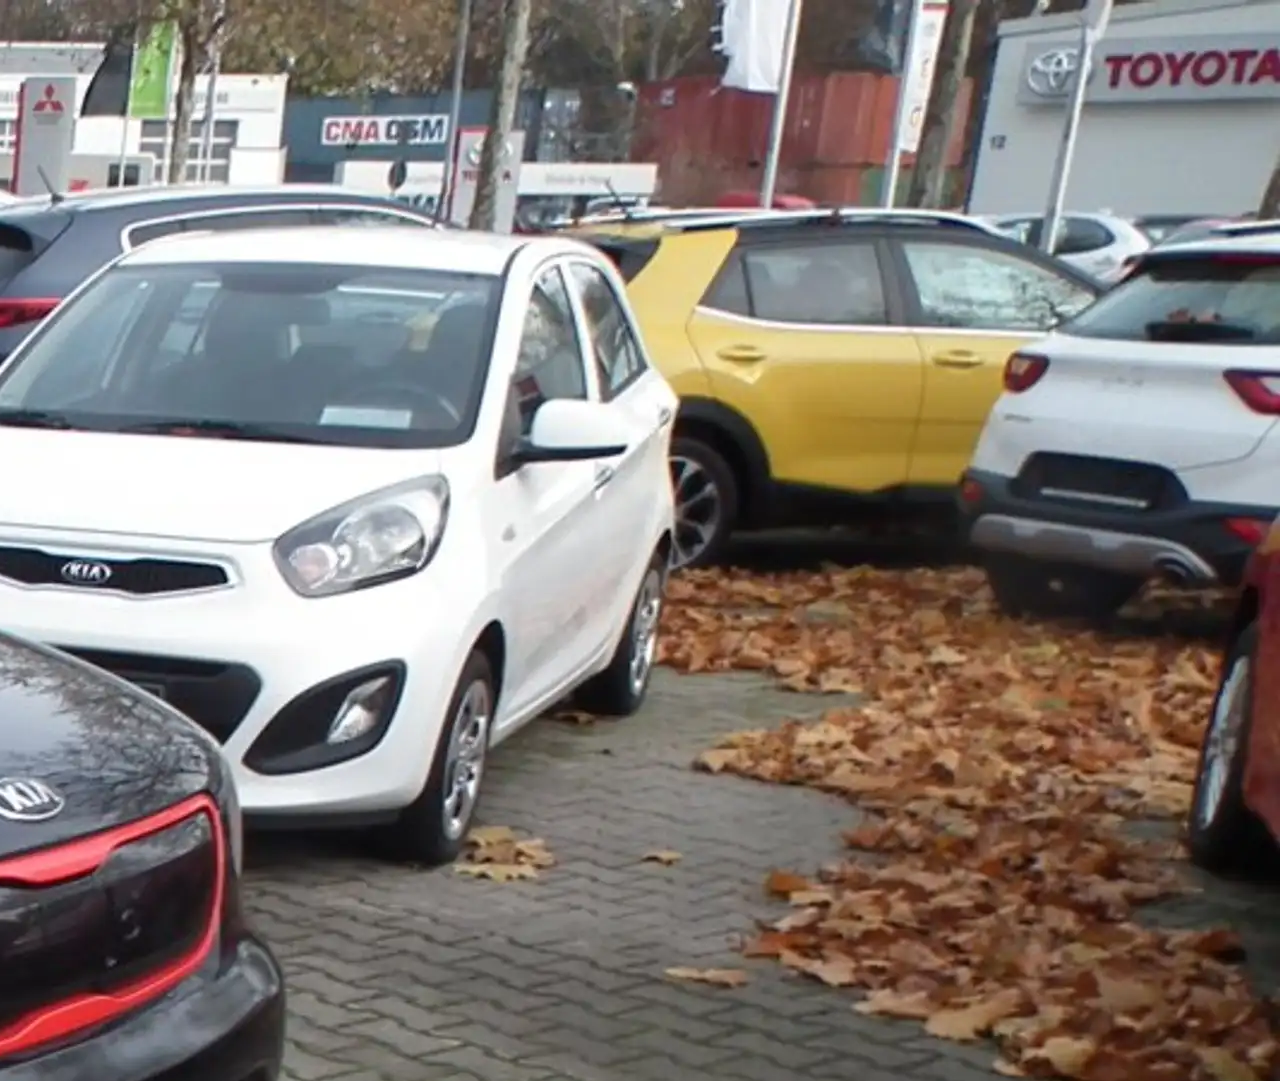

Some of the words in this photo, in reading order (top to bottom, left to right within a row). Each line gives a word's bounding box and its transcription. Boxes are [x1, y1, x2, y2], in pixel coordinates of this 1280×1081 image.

[1105, 48, 1280, 89] TOYOTA
[324, 119, 380, 142] CMA
[988, 135, 1007, 150] 12
